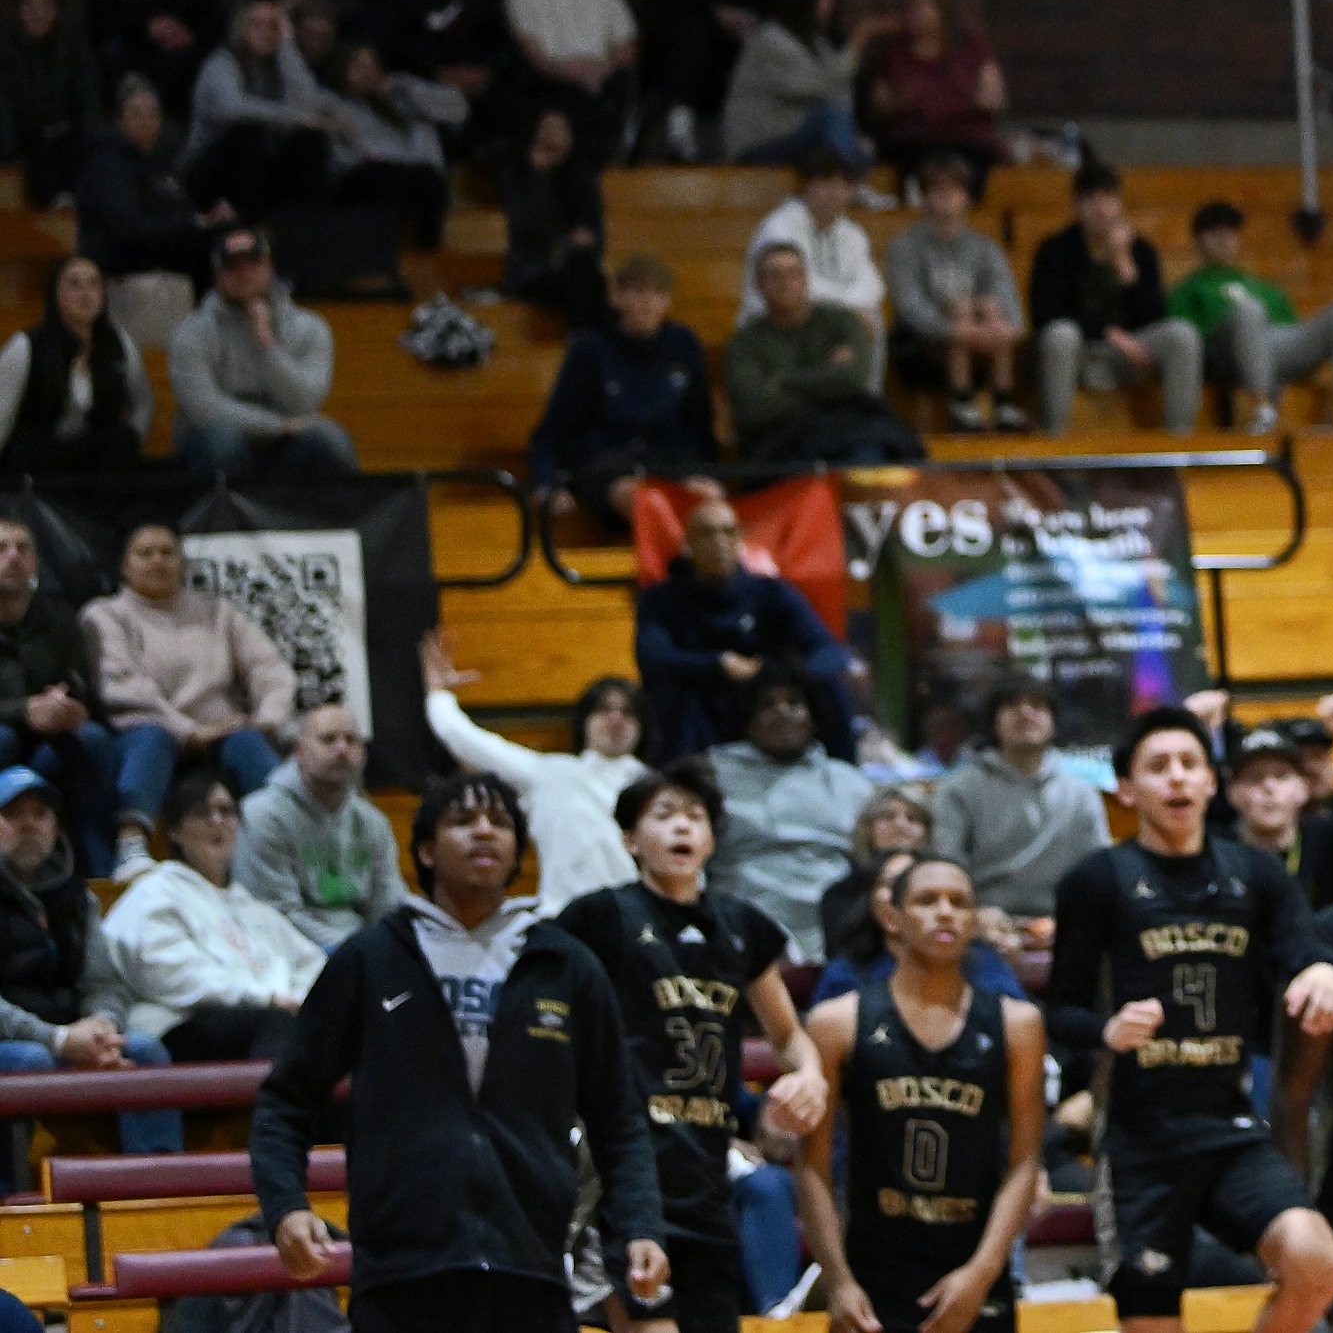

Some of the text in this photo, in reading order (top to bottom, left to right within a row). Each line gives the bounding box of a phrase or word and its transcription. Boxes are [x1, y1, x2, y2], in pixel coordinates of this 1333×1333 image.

[847, 499, 993, 581] yes
[1140, 922, 1250, 961] BOSCO
[1172, 962, 1217, 1032] 4
[876, 1075, 985, 1116] BOSCO
[902, 1117, 949, 1192] 0
